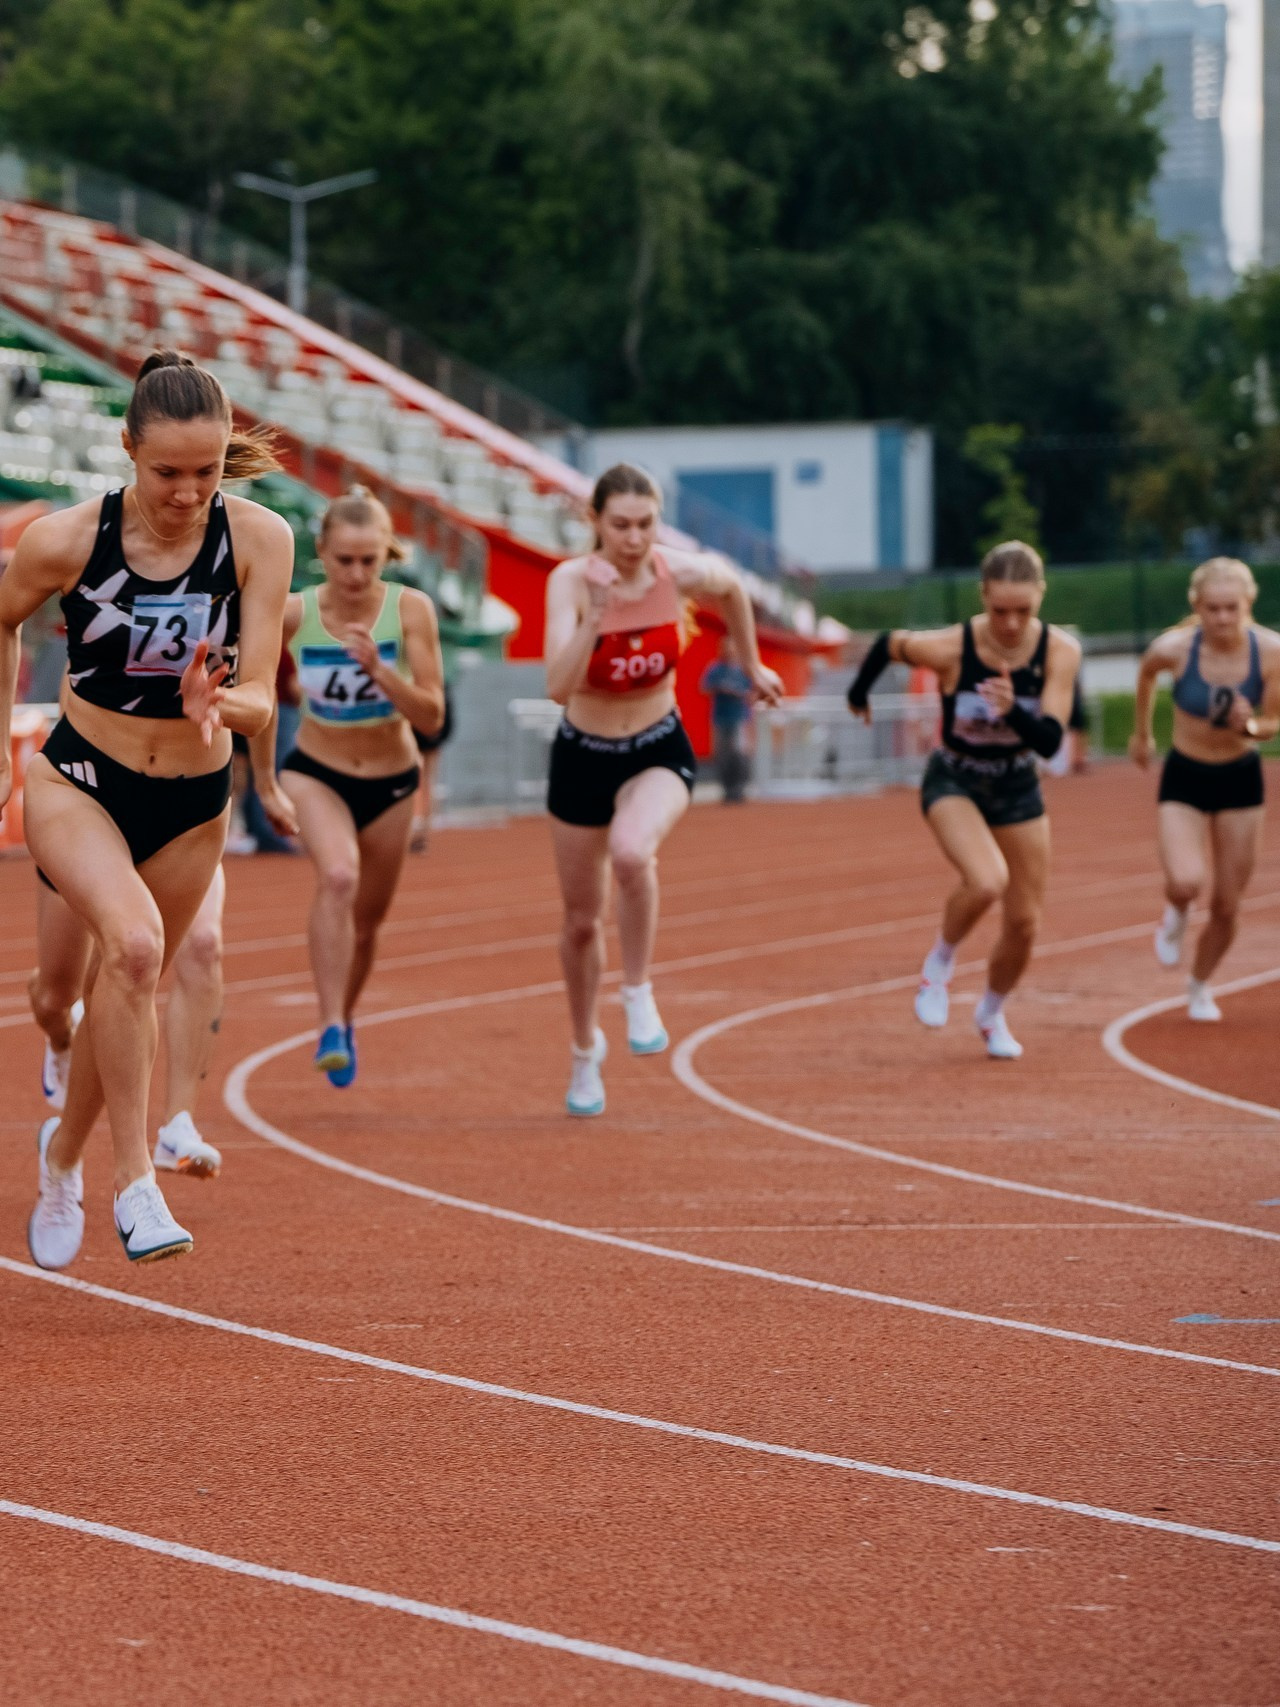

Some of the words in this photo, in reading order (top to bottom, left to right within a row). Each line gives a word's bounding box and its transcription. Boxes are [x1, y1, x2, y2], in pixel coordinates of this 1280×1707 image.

[133, 614, 188, 662] 73
[610, 652, 665, 681] 209
[324, 670, 378, 702] 42
